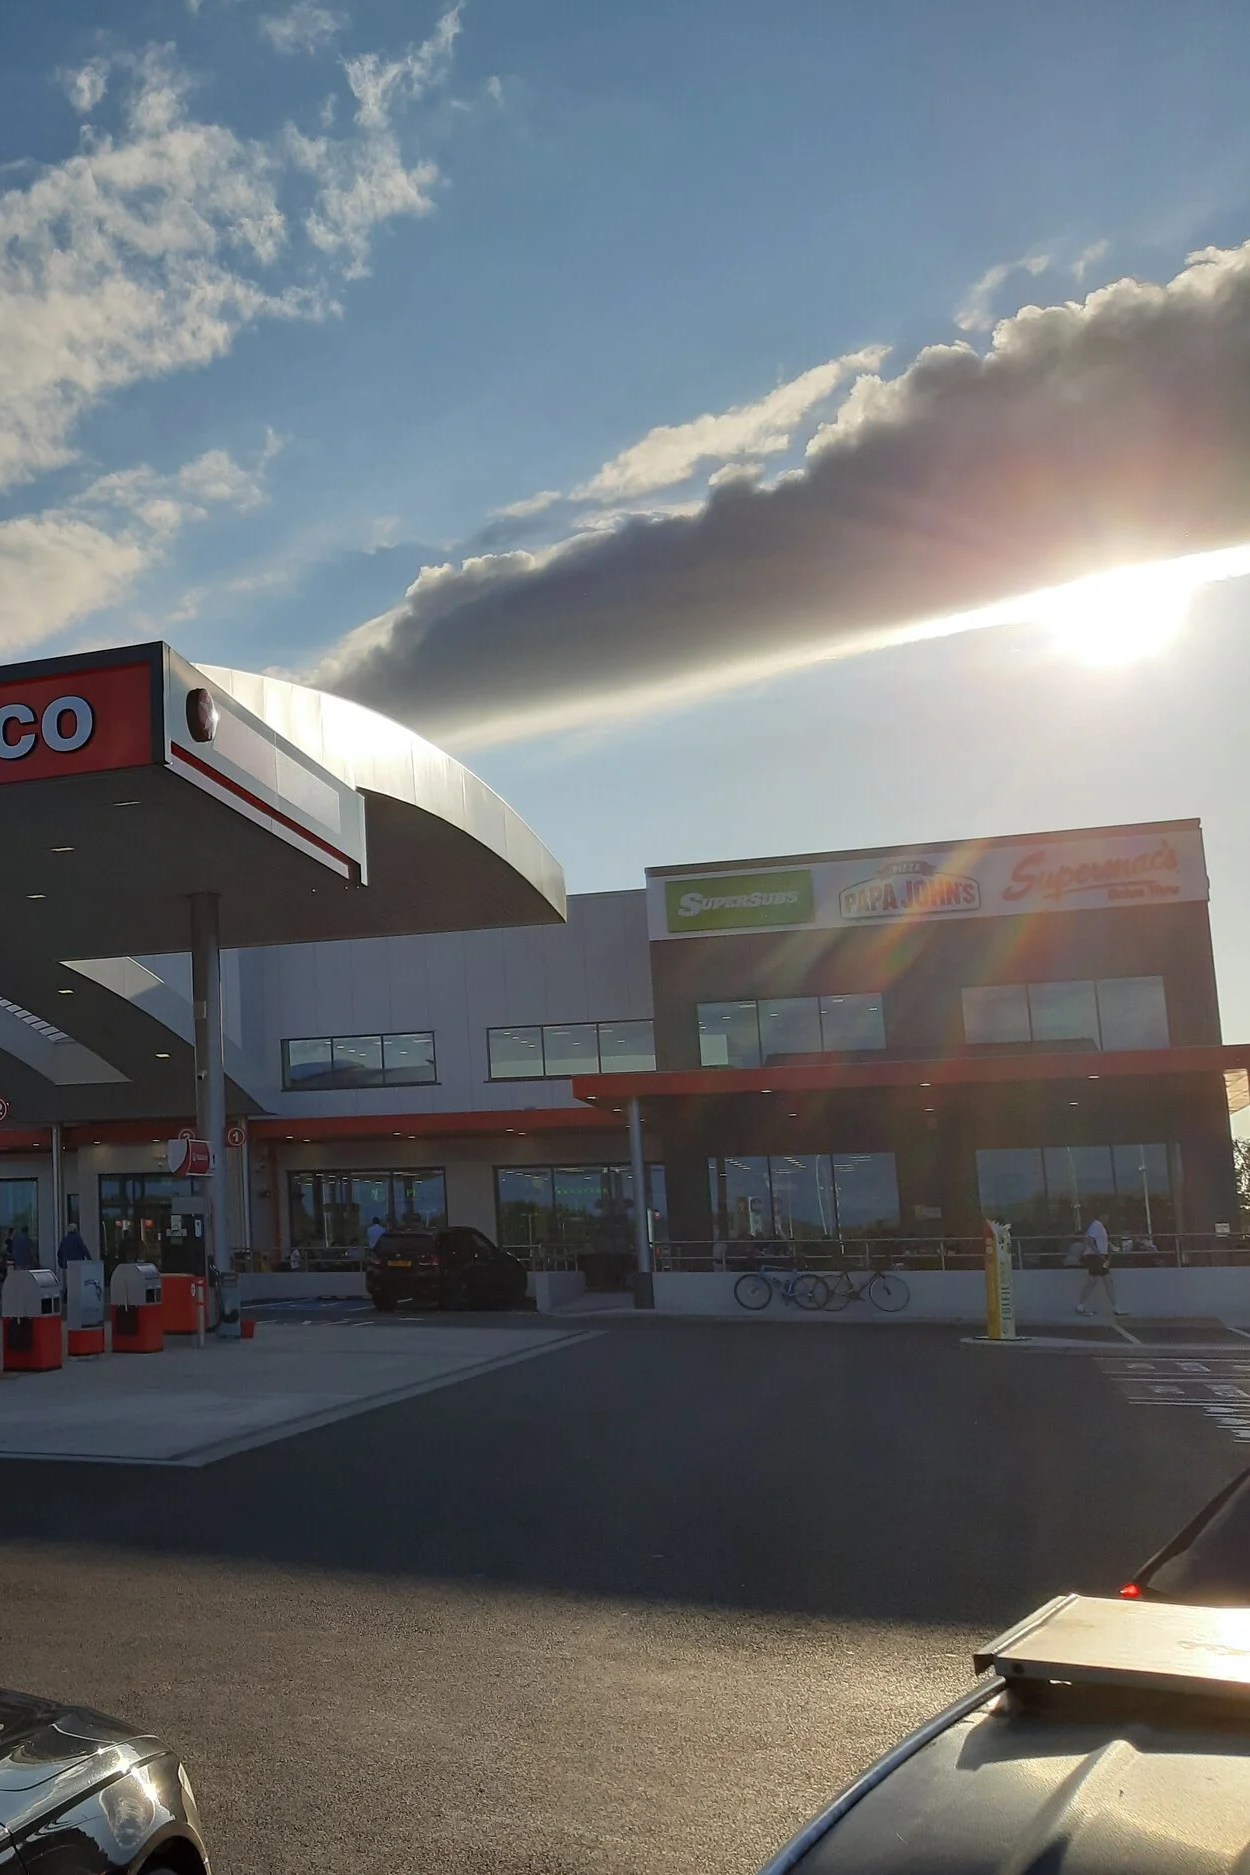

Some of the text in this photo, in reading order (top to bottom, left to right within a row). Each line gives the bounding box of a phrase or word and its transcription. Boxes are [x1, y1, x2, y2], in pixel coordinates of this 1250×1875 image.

[892, 863, 920, 874] PIZZA
[1002, 838, 1178, 901] Supermac's
[844, 880, 976, 913] PAPA JOHN'S
[232, 1131, 239, 1143] 1
